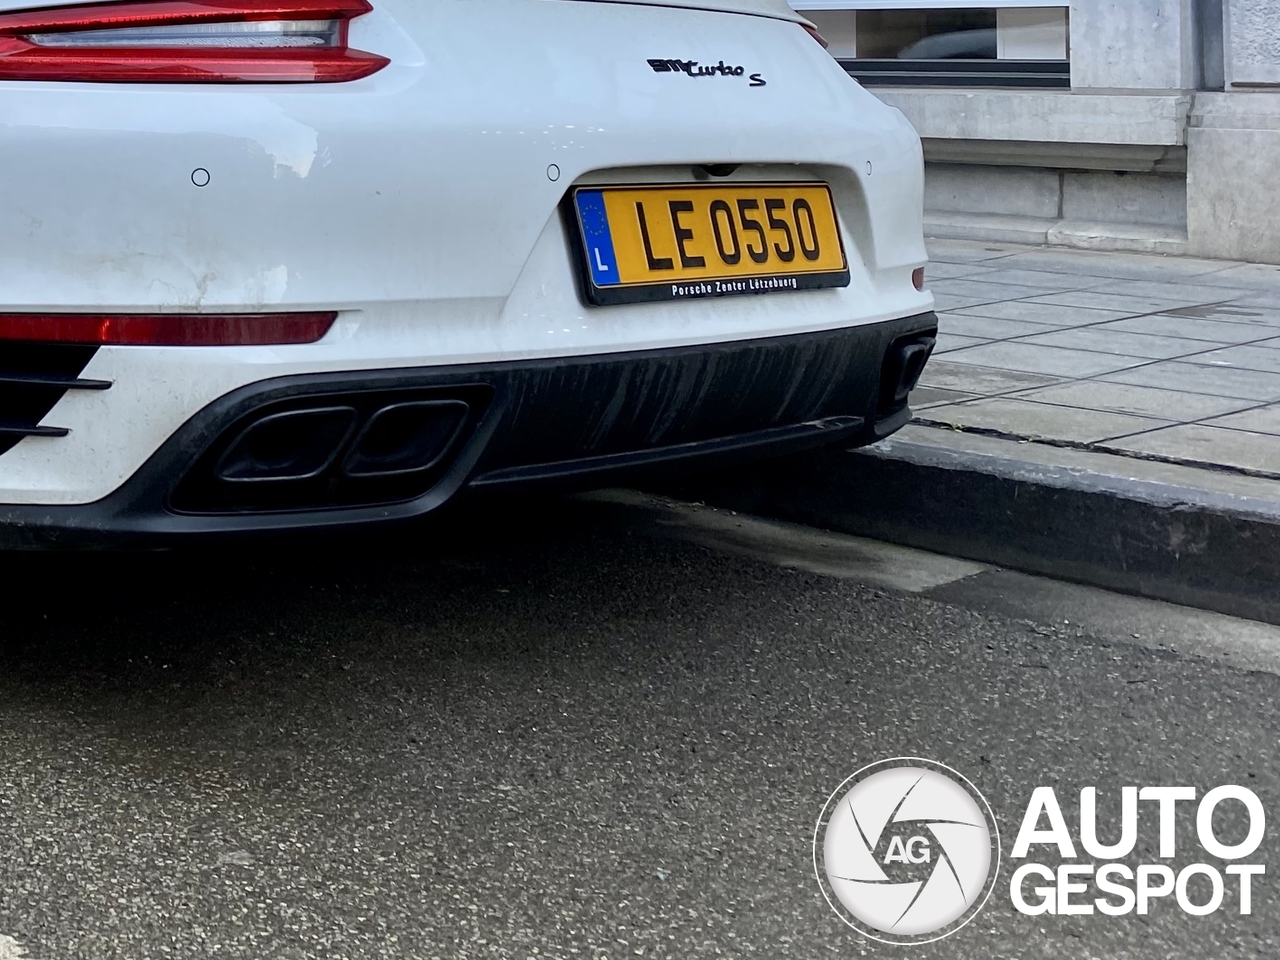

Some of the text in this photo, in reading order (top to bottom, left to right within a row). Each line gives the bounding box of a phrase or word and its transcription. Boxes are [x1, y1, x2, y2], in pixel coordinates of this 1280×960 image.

[593, 247, 609, 272] L
[671, 276, 798, 297] Porsche Zenter Lëtzebuerg
